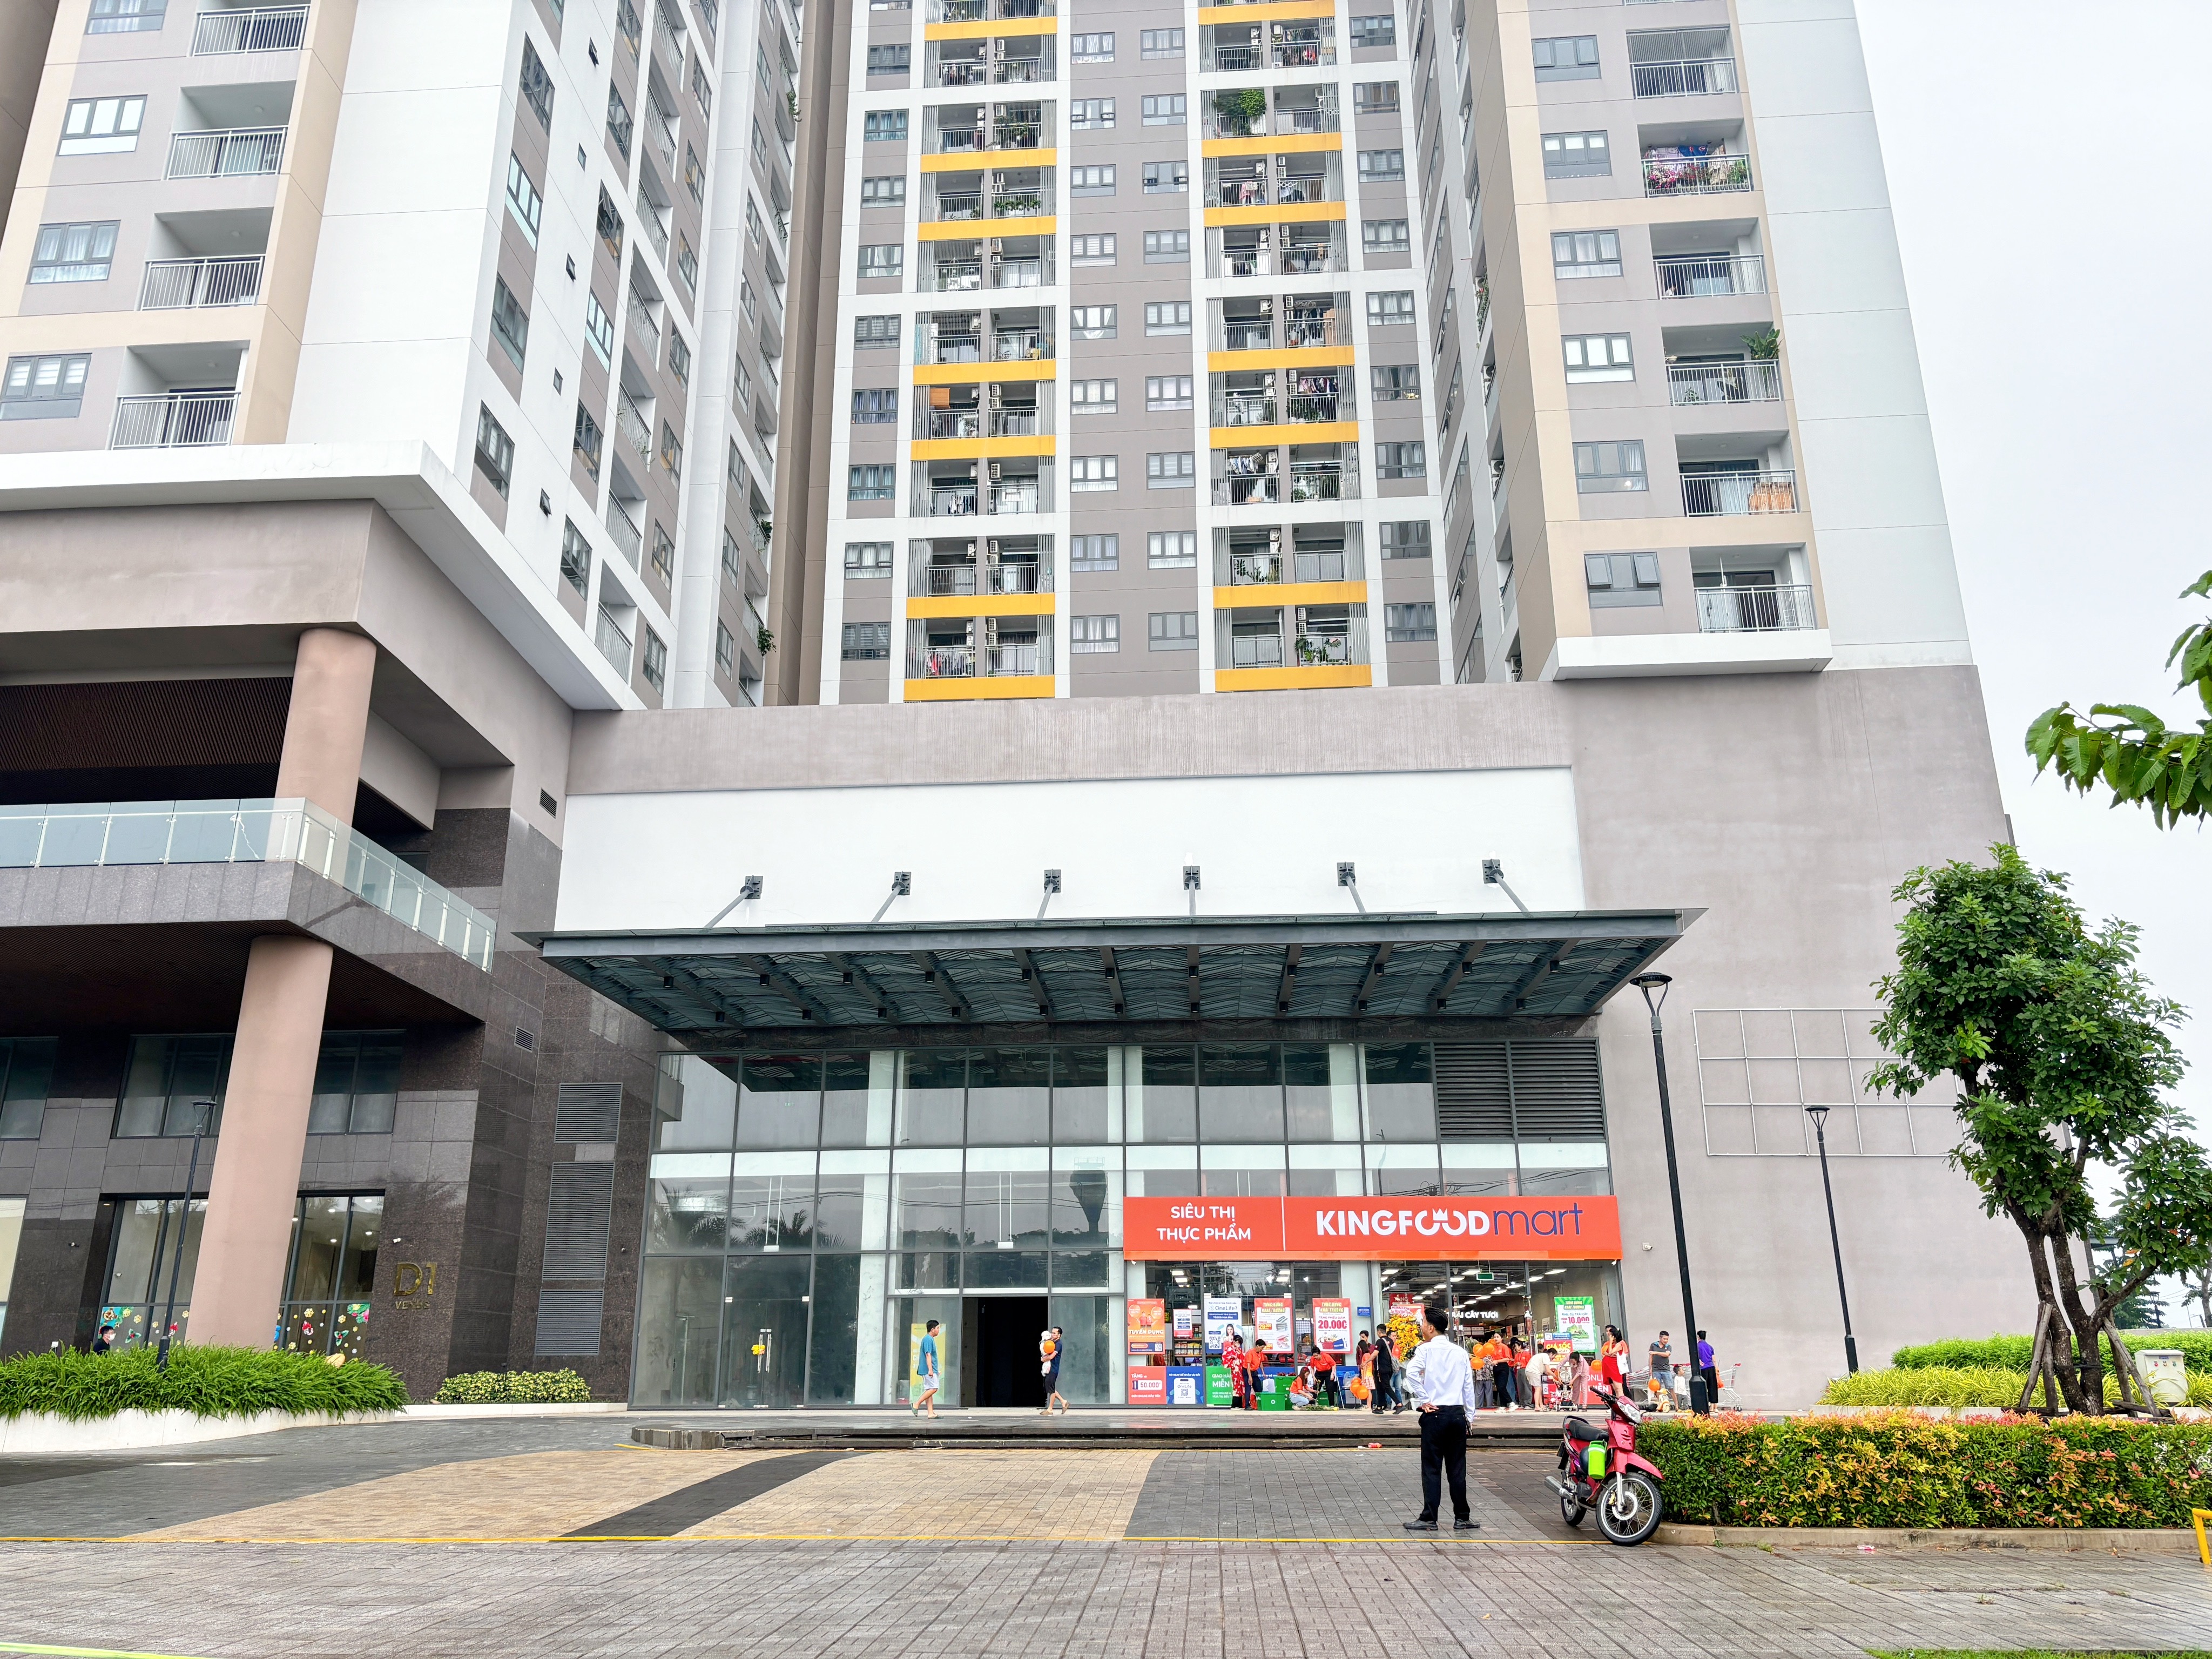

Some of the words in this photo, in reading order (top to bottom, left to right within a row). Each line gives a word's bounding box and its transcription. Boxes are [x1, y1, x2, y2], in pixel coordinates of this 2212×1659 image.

[1170, 1202, 1205, 1218] SIÊU
[1209, 1206, 1235, 1222] THỊ
[1156, 1226, 1200, 1243] THỰC
[1205, 1223, 1251, 1240] PHẨM
[394, 1262, 437, 1296] D1
[1465, 1310, 1480, 1319] CÂY
[1212, 1378, 1230, 1387] MIỄN
